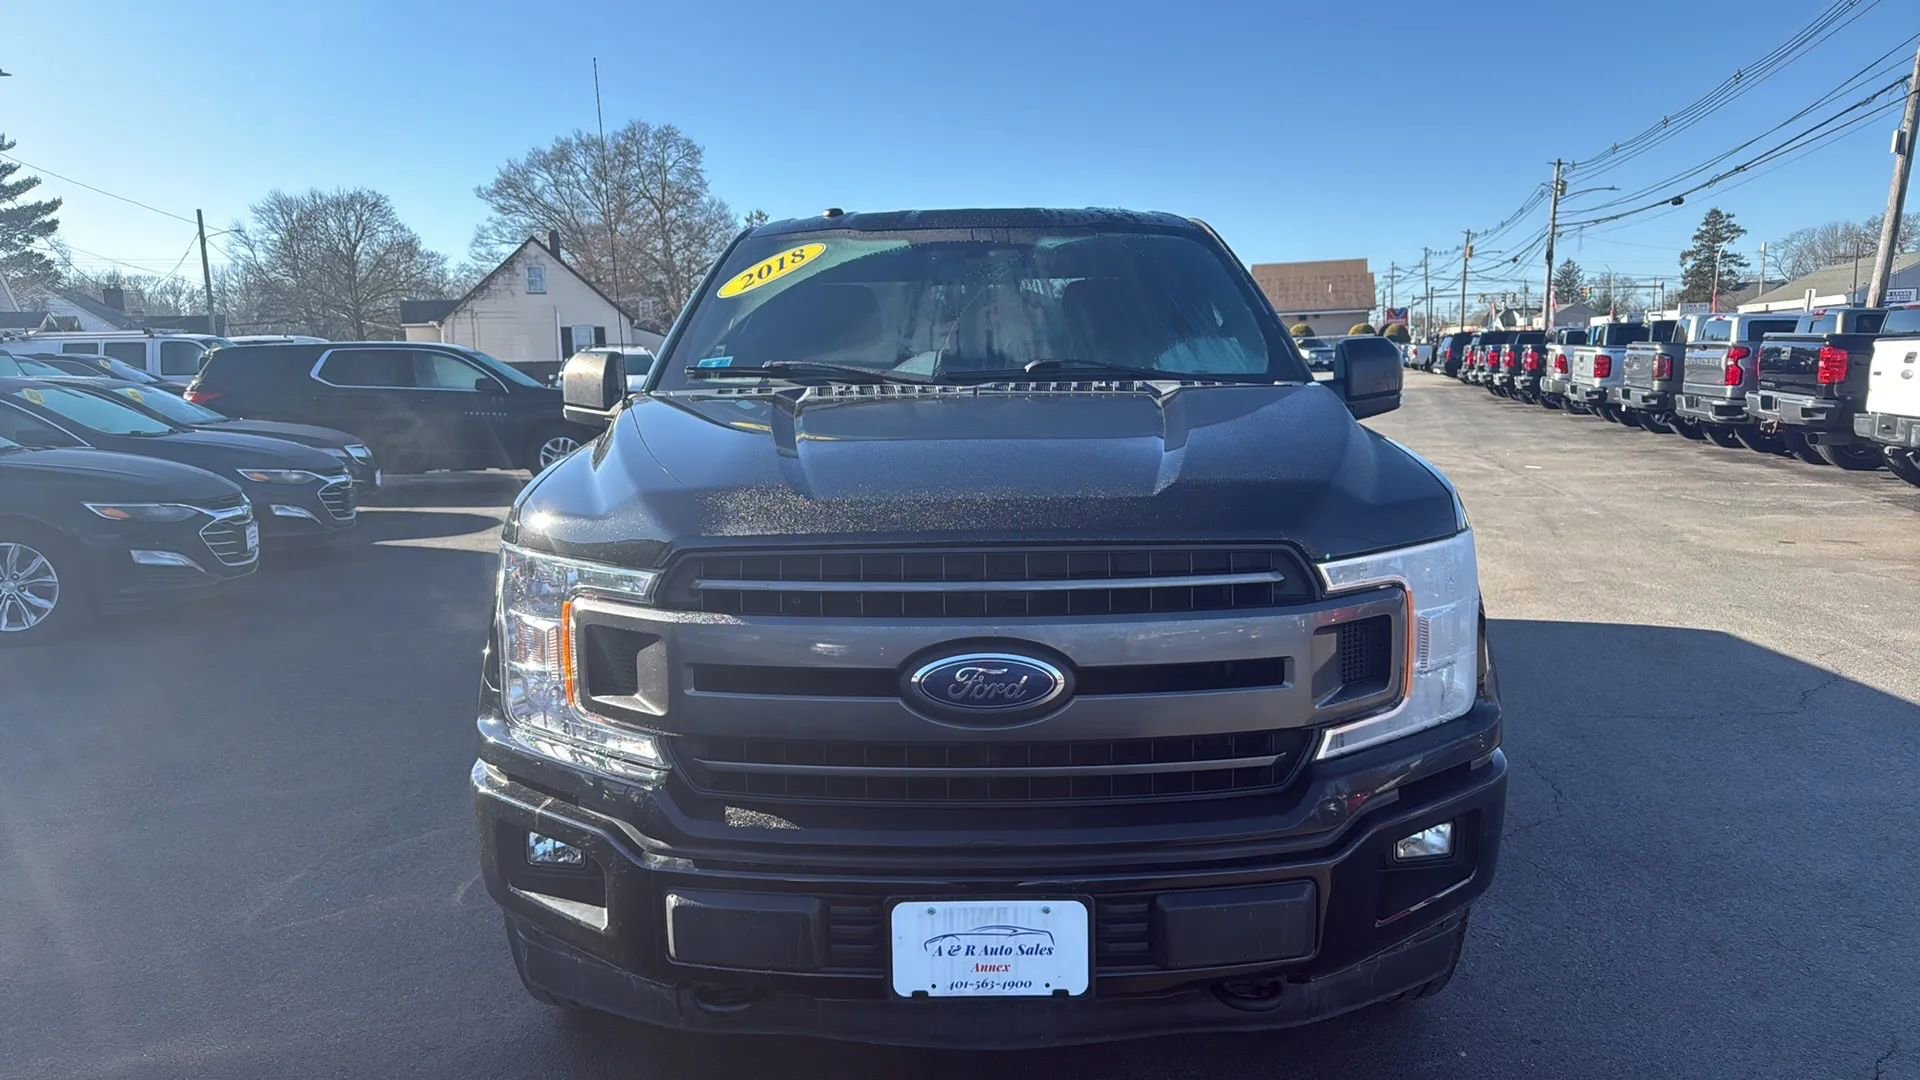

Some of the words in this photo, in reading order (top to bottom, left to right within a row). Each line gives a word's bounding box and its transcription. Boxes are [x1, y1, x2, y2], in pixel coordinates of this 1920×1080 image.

[740, 249, 805, 290] 2018
[948, 667, 1029, 699] Ford
[932, 944, 943, 957] A
[947, 944, 962, 957] &
[964, 944, 976, 957] R
[979, 944, 1013, 957] Auto
[1016, 943, 1054, 956] Sales
[970, 962, 1011, 973] Annex
[948, 978, 1033, 990] 401-563-4900
